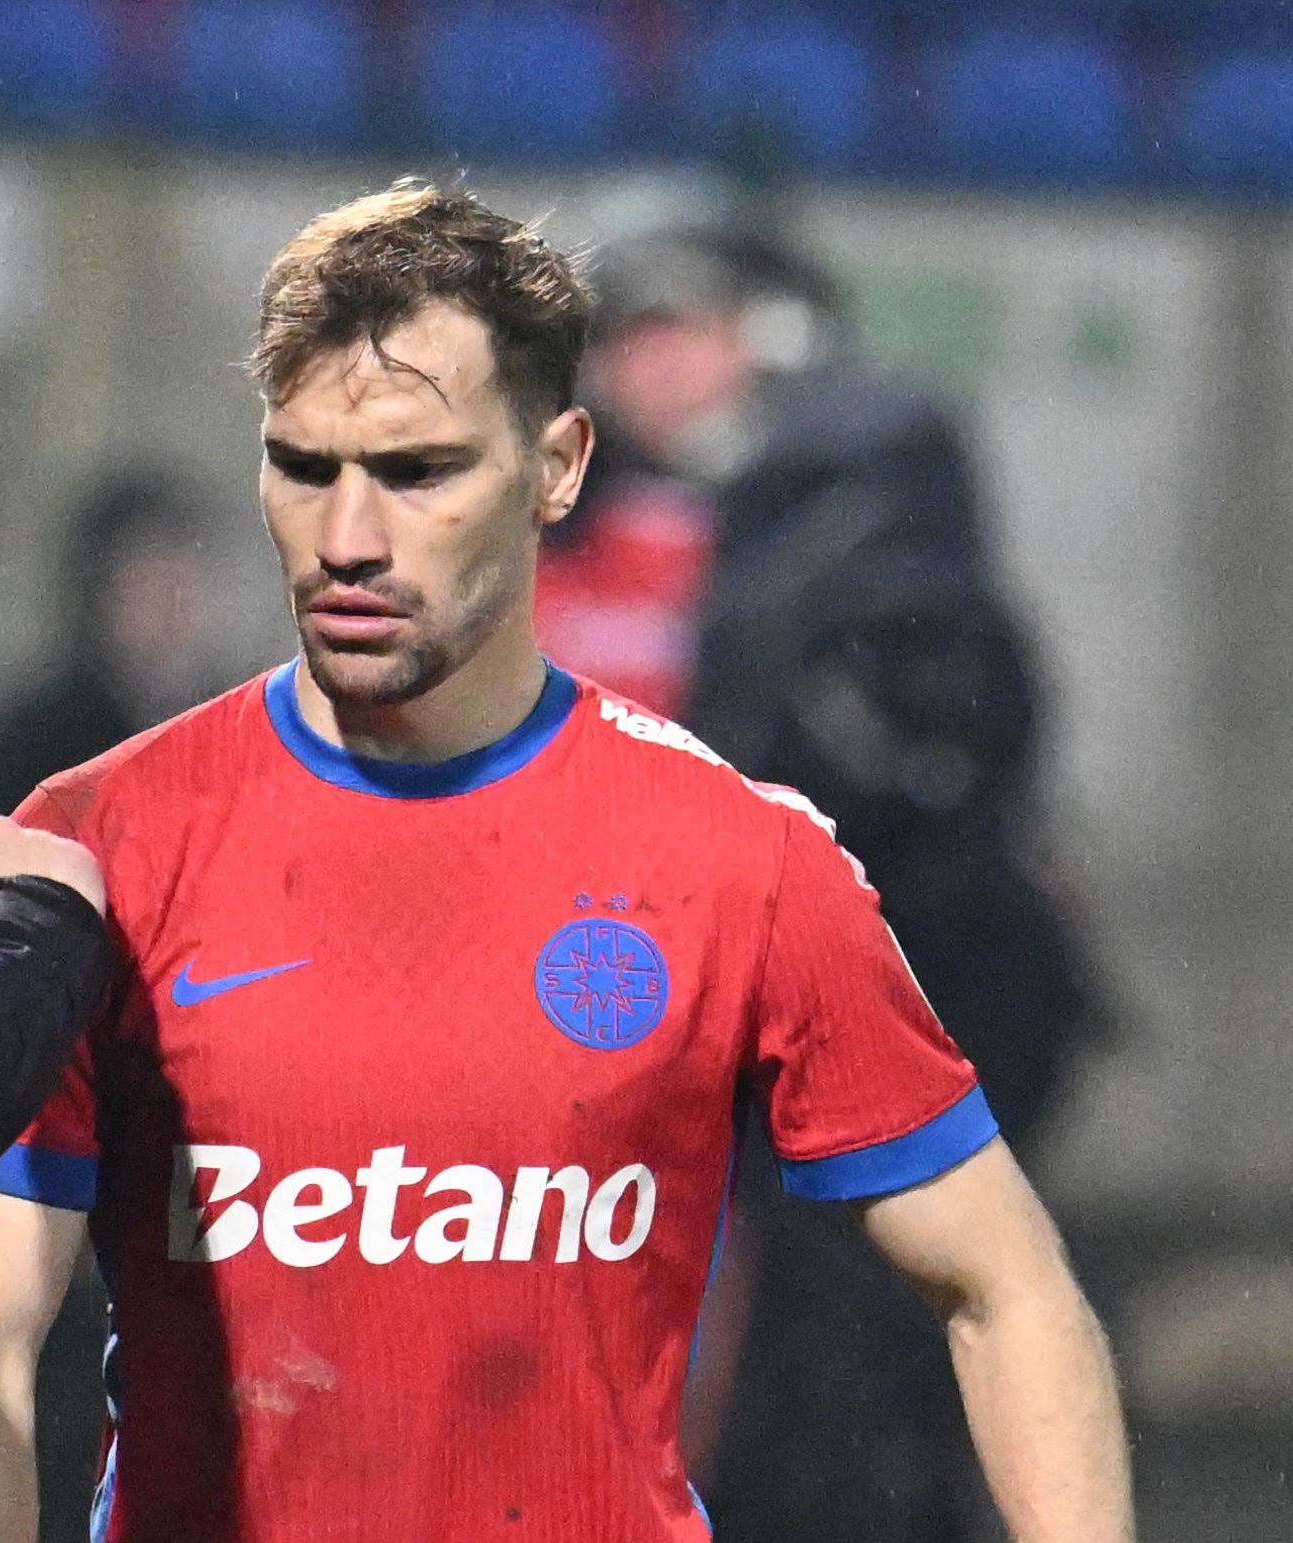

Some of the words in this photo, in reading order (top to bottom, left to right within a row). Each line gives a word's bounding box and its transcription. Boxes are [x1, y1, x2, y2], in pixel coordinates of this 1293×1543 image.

[544, 972, 560, 988] S
[596, 1025, 611, 1041] C
[168, 1144, 657, 1268] Betano
